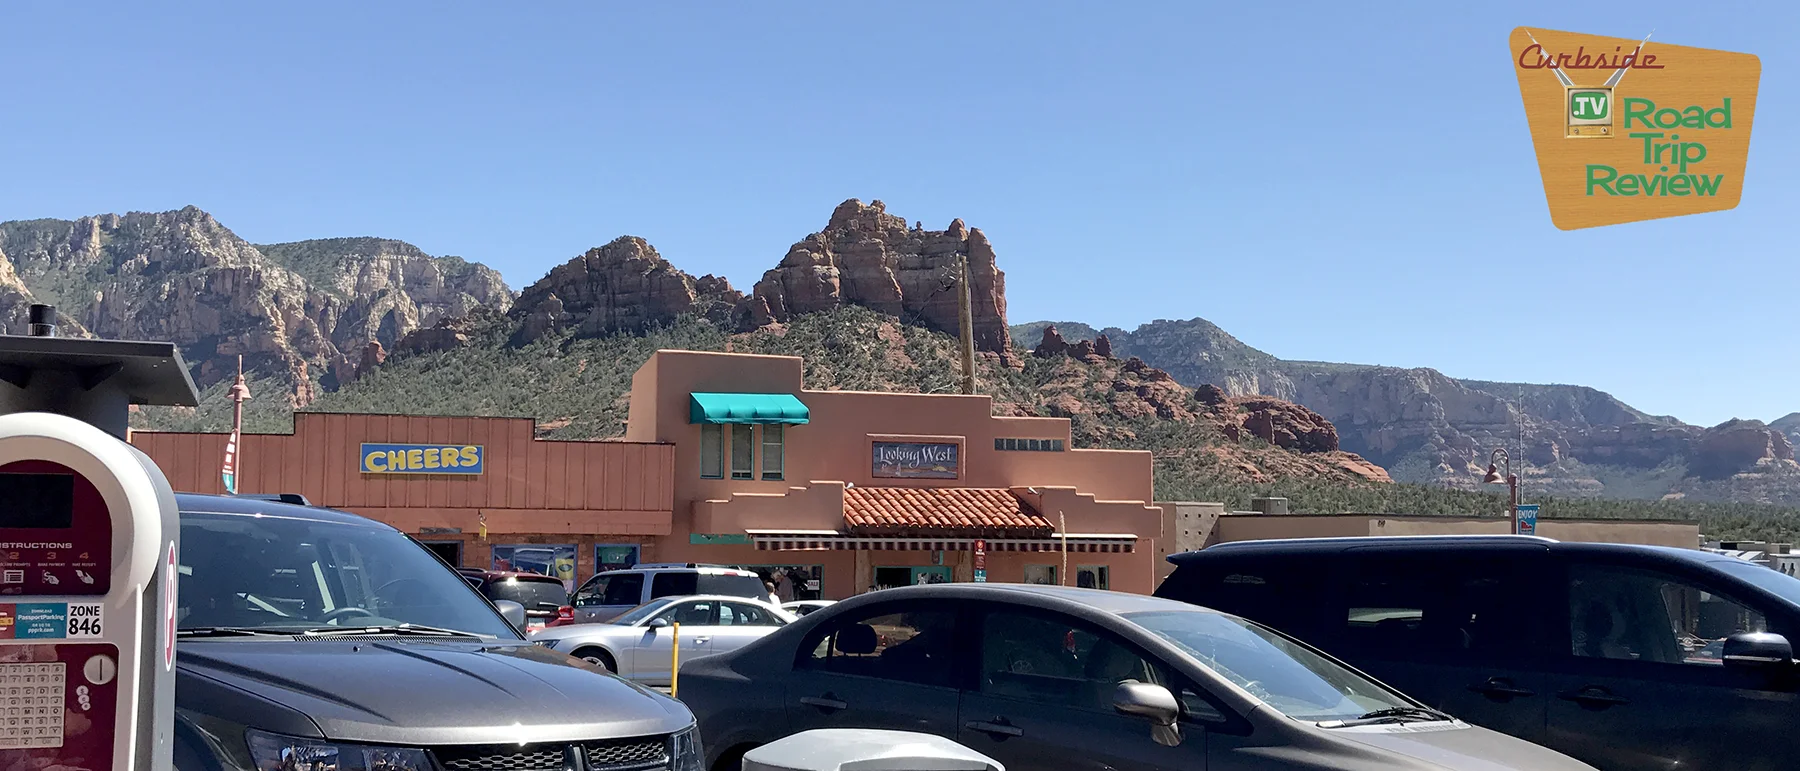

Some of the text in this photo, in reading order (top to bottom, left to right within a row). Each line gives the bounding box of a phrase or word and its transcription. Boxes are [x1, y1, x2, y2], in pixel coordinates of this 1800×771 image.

[365, 446, 479, 472] CHEERS
[879, 445, 952, 469] Looking West
[1518, 510, 1538, 519] ENJOY
[47, 552, 57, 560] 3
[70, 606, 100, 616] ZONE
[68, 618, 101, 635] 846
